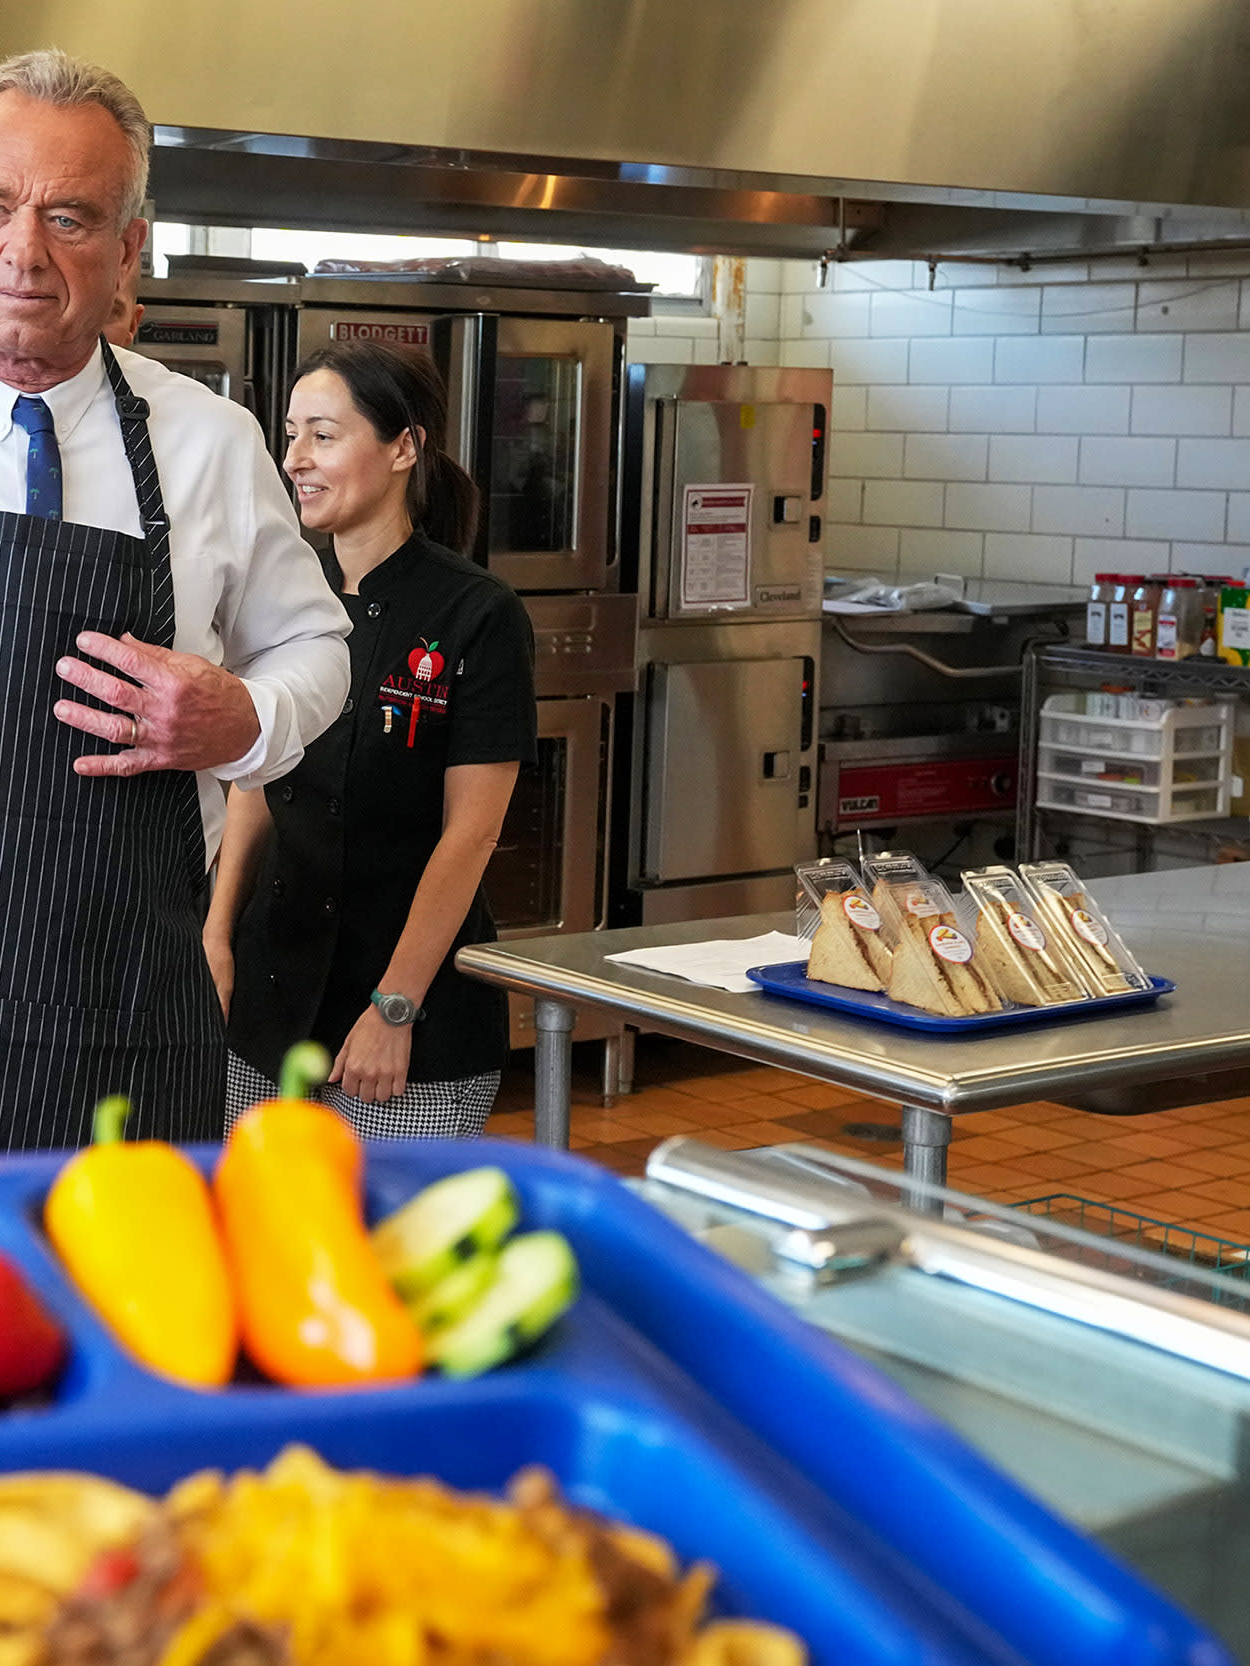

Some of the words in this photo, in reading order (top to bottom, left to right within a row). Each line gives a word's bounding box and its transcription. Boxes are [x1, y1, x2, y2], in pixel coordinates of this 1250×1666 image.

[153, 331, 215, 341] GARLAND
[339, 324, 425, 343] BLODGETT
[382, 674, 449, 699] AUSTIN
